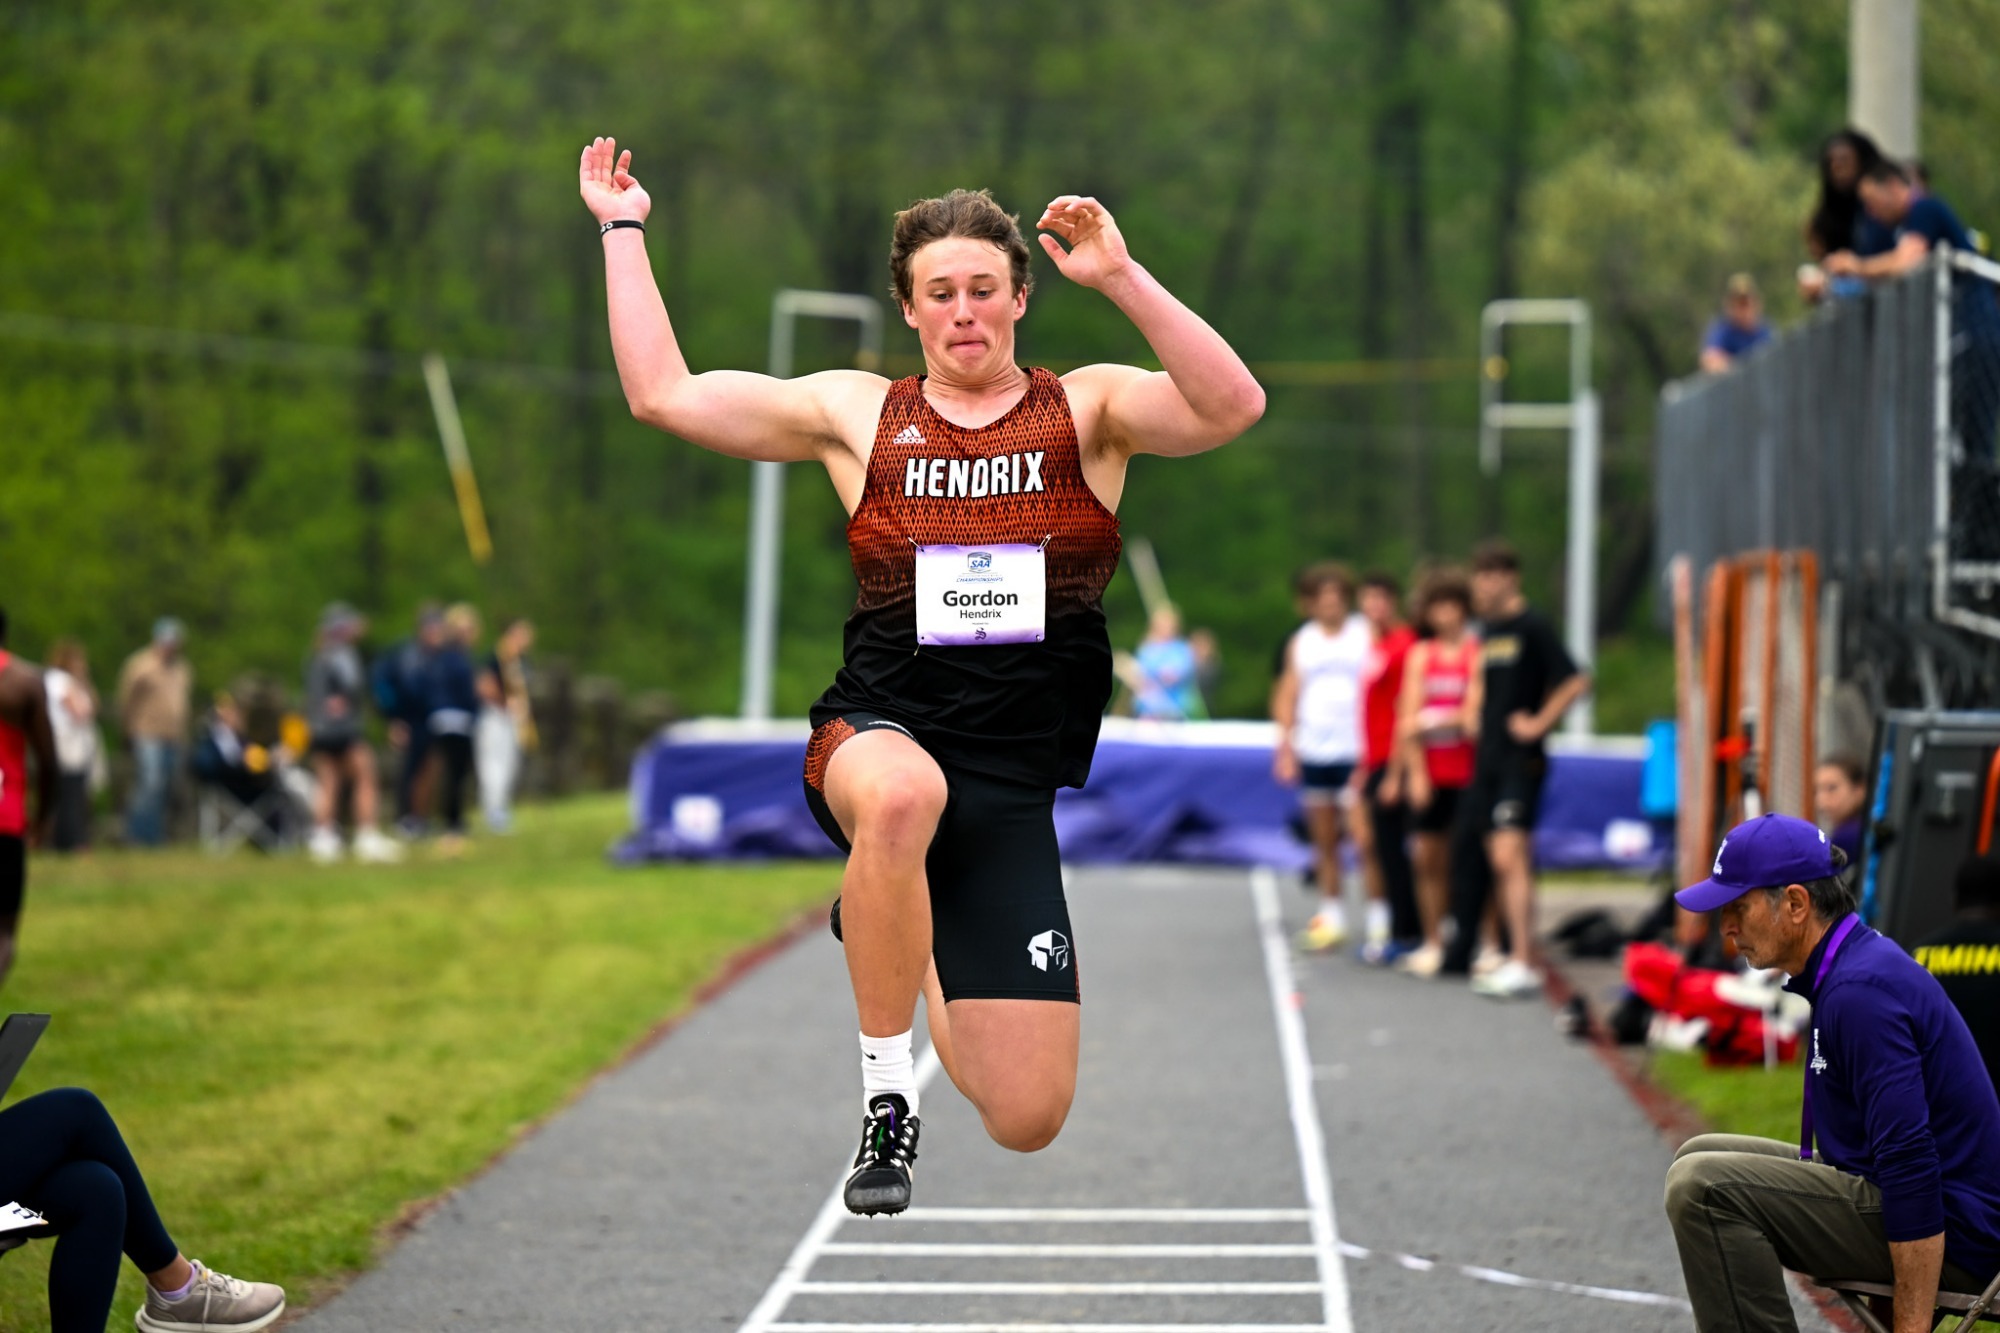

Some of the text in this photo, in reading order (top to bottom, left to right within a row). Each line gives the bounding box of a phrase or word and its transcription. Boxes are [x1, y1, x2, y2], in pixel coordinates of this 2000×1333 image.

[893, 436, 926, 445] adidas
[904, 450, 1045, 499] HENDRIX
[970, 559, 991, 569] SAA
[942, 589, 1019, 607] Gordon
[959, 608, 1002, 619] Hendrix
[1912, 944, 2000, 976] TIMIN
